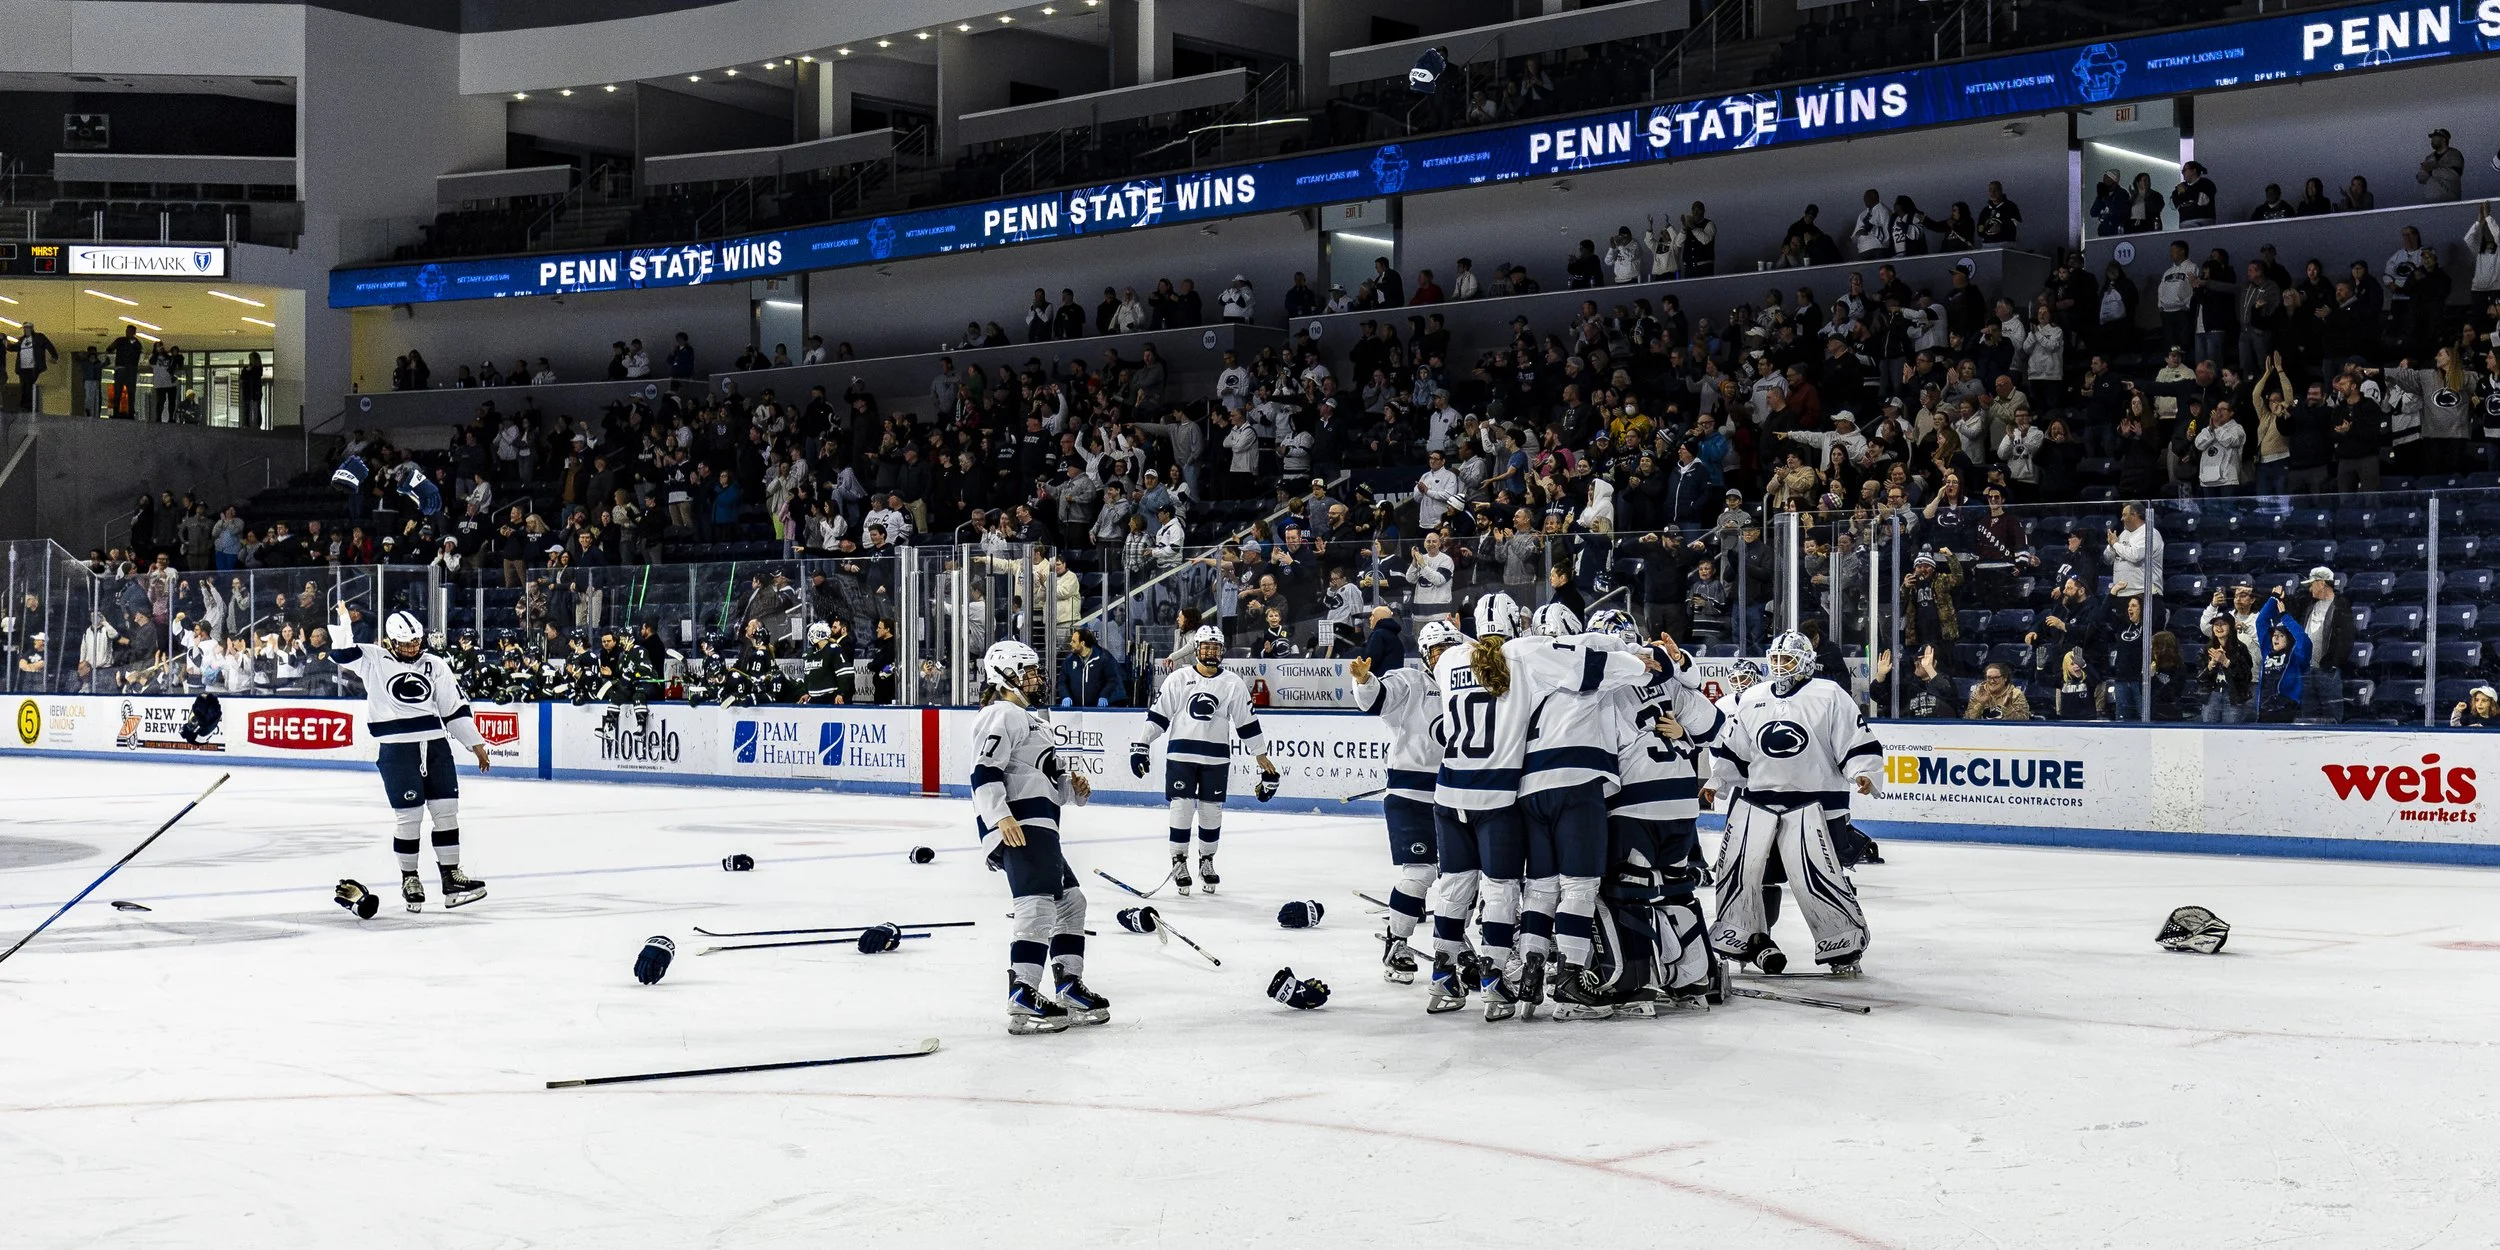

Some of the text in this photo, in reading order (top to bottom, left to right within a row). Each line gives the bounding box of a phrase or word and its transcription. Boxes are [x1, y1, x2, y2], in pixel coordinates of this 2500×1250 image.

[2303, 5, 2450, 61] PENN
[2147, 47, 2244, 69] NITTANY LIONS WIN
[1965, 74, 2055, 95] NITTANY LIONS WIN
[1530, 83, 1908, 164] PENN STATE WINS
[2115, 108, 2131, 121] EXIT
[984, 174, 1255, 236] PENN STATE WINS
[31, 246, 59, 257] MHRST
[81, 250, 187, 272] HIGHMARK
[2118, 249, 2131, 259] 111
[540, 240, 782, 286] PENN STATE WINS
[1488, 624, 1496, 633] 10
[639, 650, 645, 658] 7
[840, 653, 845, 663] 1
[424, 662, 433, 677] A
[752, 661, 762, 672] 18
[1277, 664, 1332, 678] HIGHMARK
[772, 683, 781, 693] 19
[855, 687, 876, 696] MARK
[1277, 688, 1333, 701] HIGHMARK
[24, 710, 34, 734] 5
[145, 708, 175, 720] NEW
[253, 716, 347, 742] SHEETZ
[480, 716, 513, 738] bryant
[763, 721, 798, 742] PAM
[850, 723, 887, 744] PAM
[1444, 692, 1496, 758] 10
[602, 715, 680, 763] Modelo
[1882, 744, 1932, 752] PLOYEE-OWNED
[763, 744, 816, 765] HEALTH
[850, 745, 906, 768] HEALTH
[1334, 741, 1390, 760] CREEK
[2321, 753, 2477, 804] weis
[1880, 791, 2083, 807] OMMERCIAL MECHANICAL CONTRACTORS
[2400, 808, 2477, 823] markets
[1815, 940, 1849, 955] State
